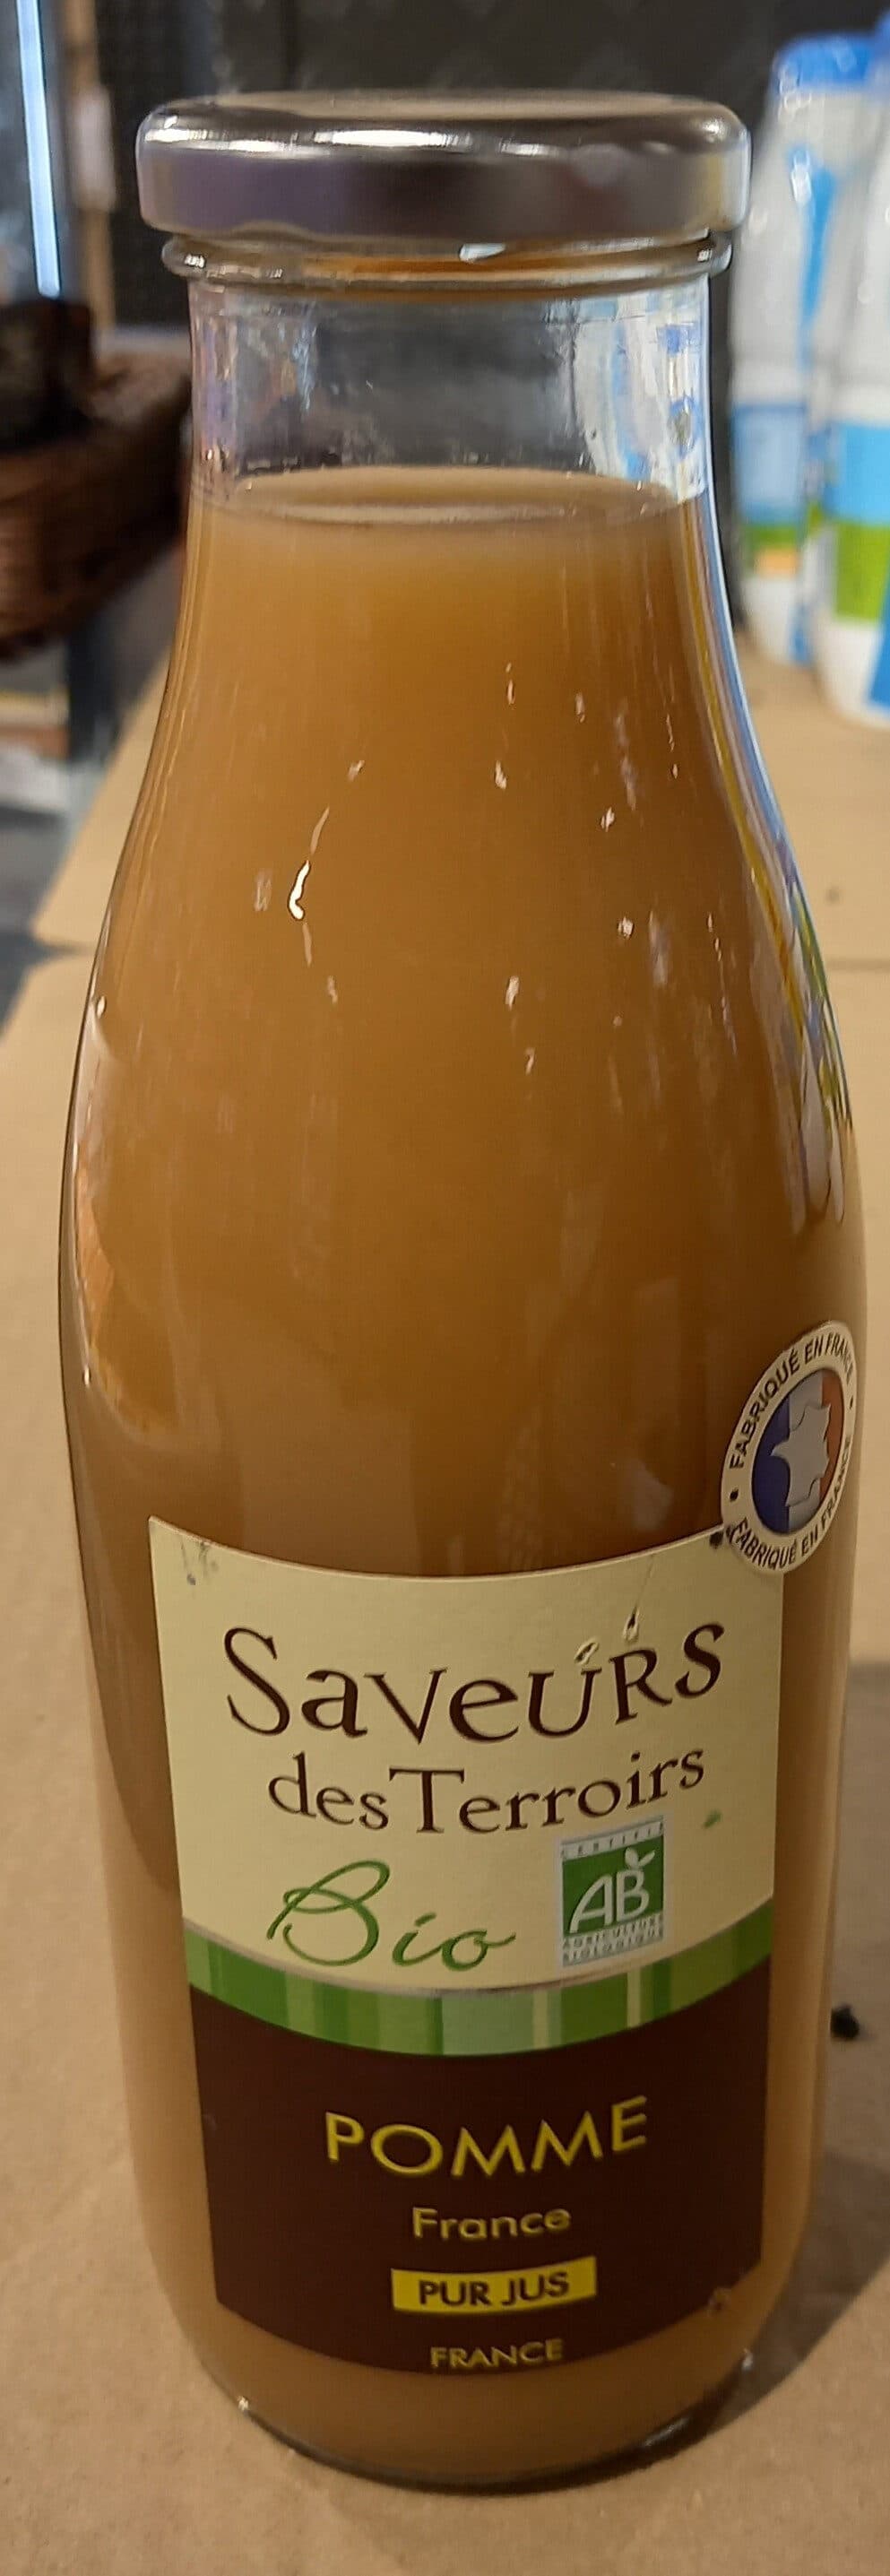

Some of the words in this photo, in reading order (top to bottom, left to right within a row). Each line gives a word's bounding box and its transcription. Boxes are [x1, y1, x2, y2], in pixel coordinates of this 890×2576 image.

[729, 1347, 801, 1470] FABRIQUÉ
[805, 1334, 824, 1365] EN
[824, 1331, 853, 1385] FRANCE
[728, 1516, 798, 1571] FABRIQUÉ
[801, 1525, 818, 1556] EN
[389, 1748, 705, 1834] Terroirs
[266, 1860, 516, 1973] Bio
[568, 1868, 650, 1934] AB
[324, 2095, 648, 2179] POMME
[412, 2207, 573, 2241] France
[418, 2278, 492, 2307] PUR
[501, 2271, 571, 2306] JUS
[430, 2337, 565, 2370] FRANCE
